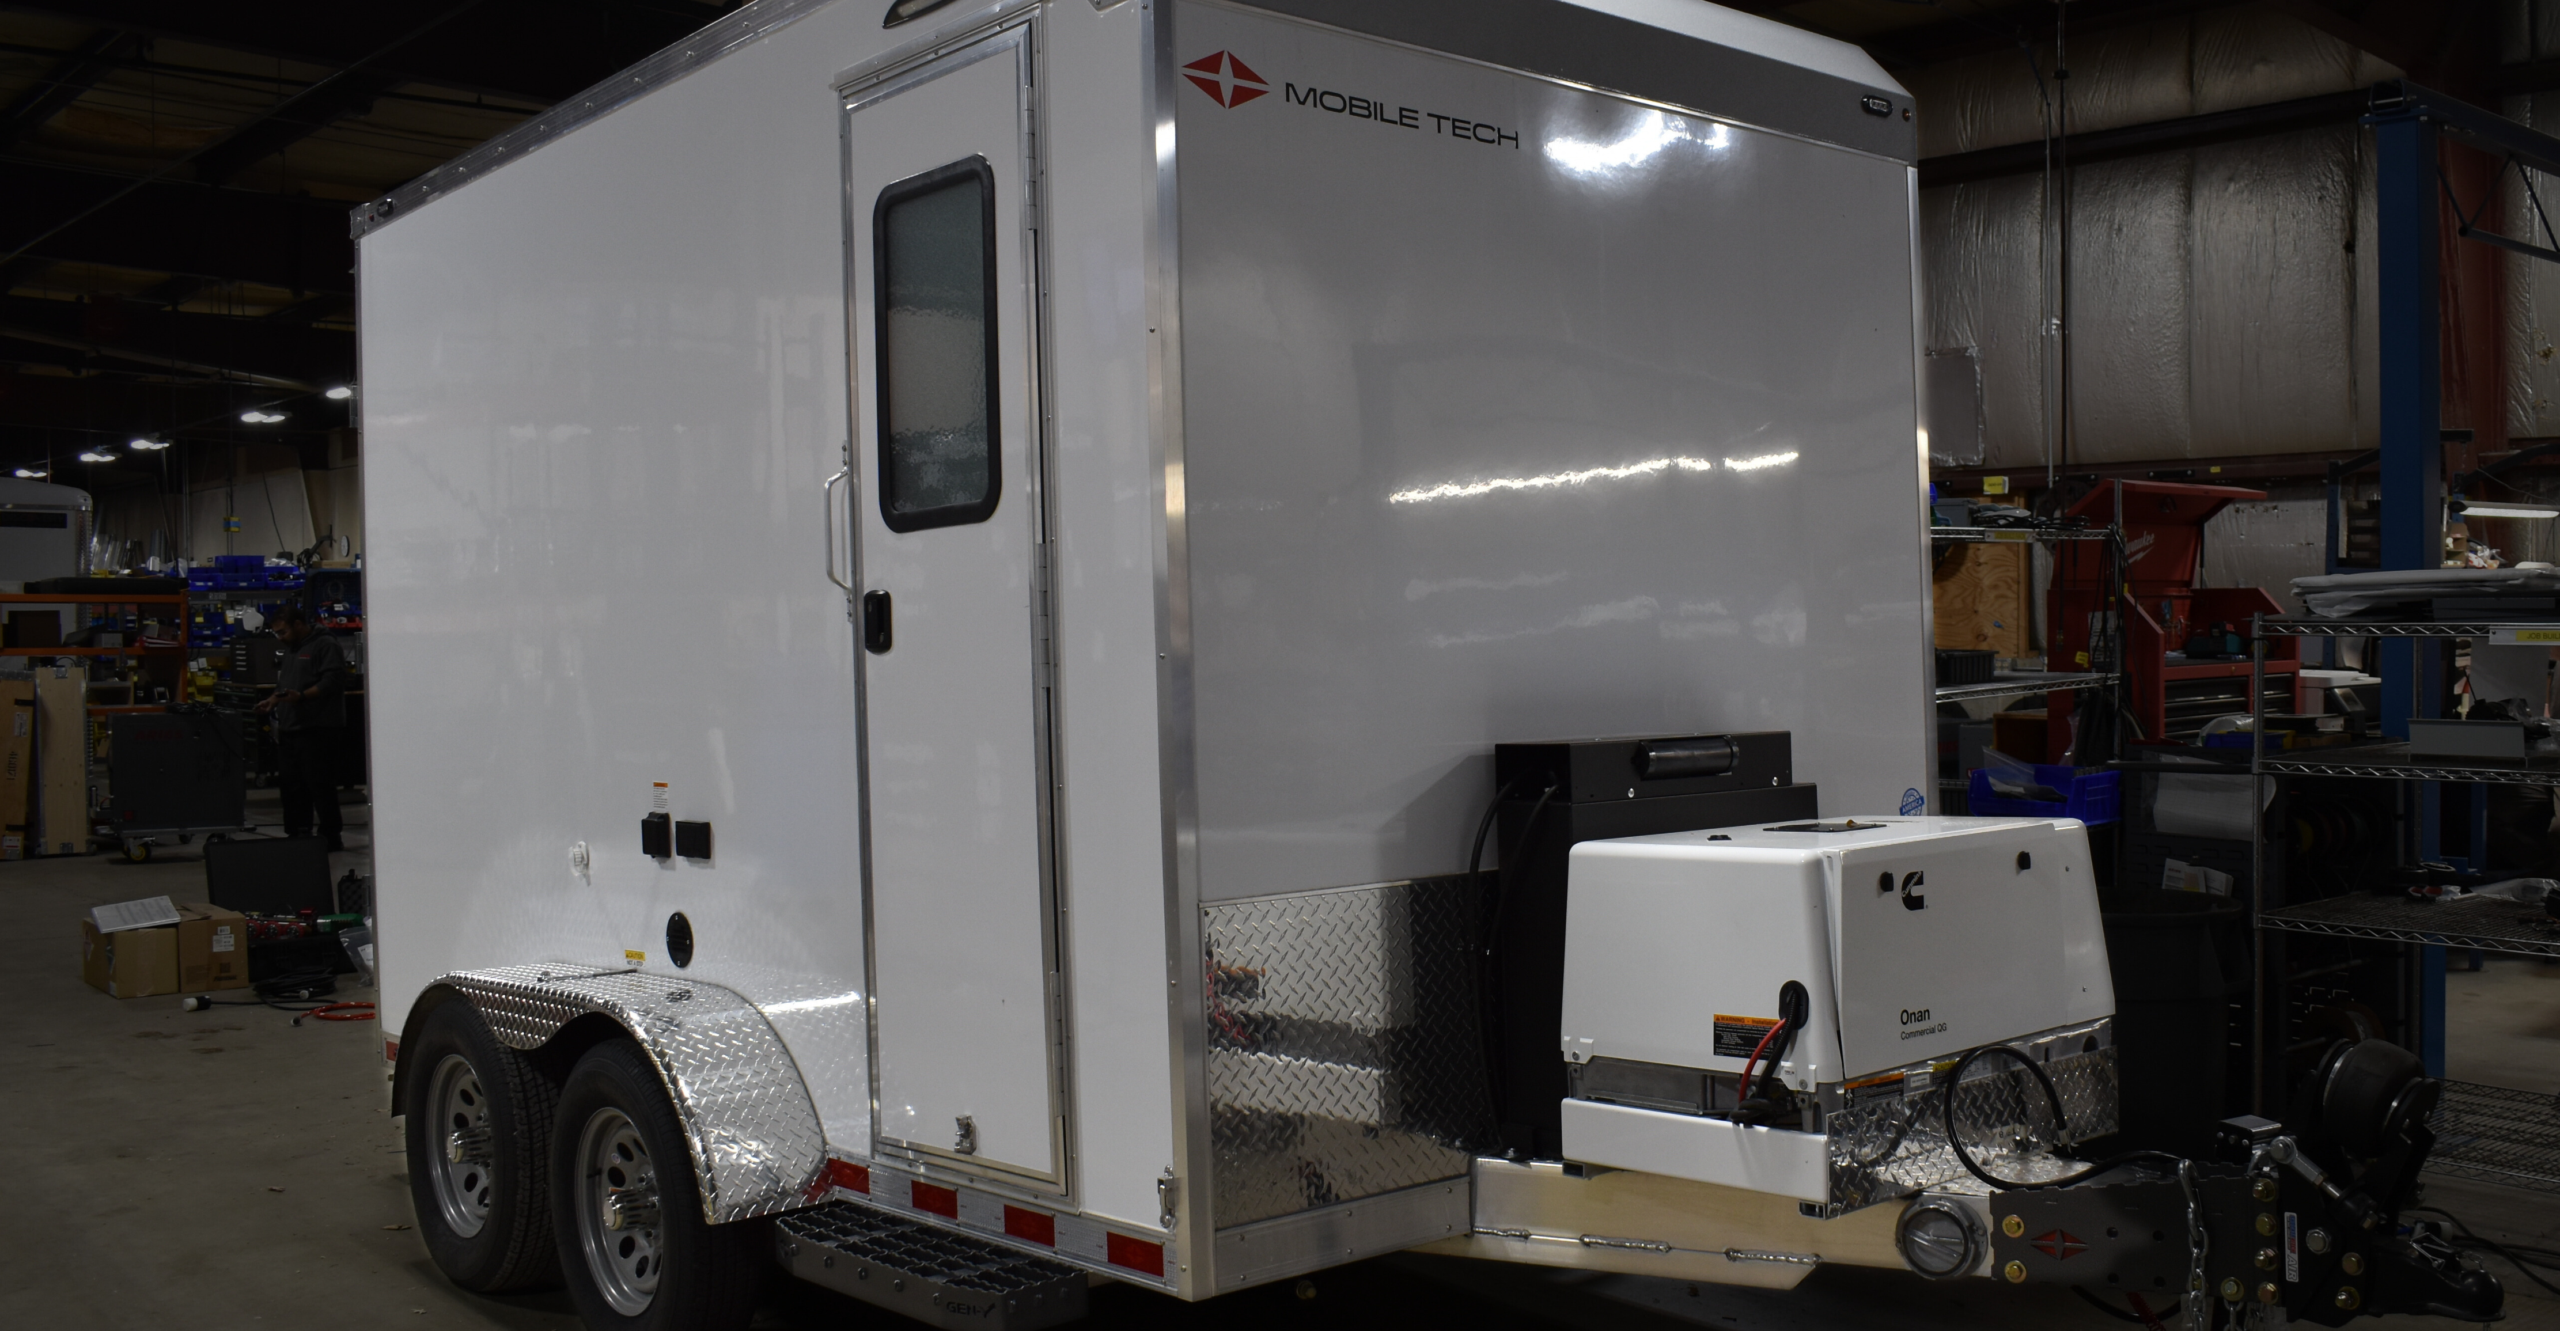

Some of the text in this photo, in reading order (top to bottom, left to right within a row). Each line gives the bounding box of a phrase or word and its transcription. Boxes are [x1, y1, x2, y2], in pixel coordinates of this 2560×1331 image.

[1285, 82, 1519, 149] MOBILE TECH
[2527, 632, 2541, 640] JOB
[1720, 1015, 1745, 1024] WARNING
[1900, 1008, 1930, 1025] Onan
[1900, 1022, 1947, 1040] Commercial QG
[946, 1301, 996, 1318] GEN-Y
